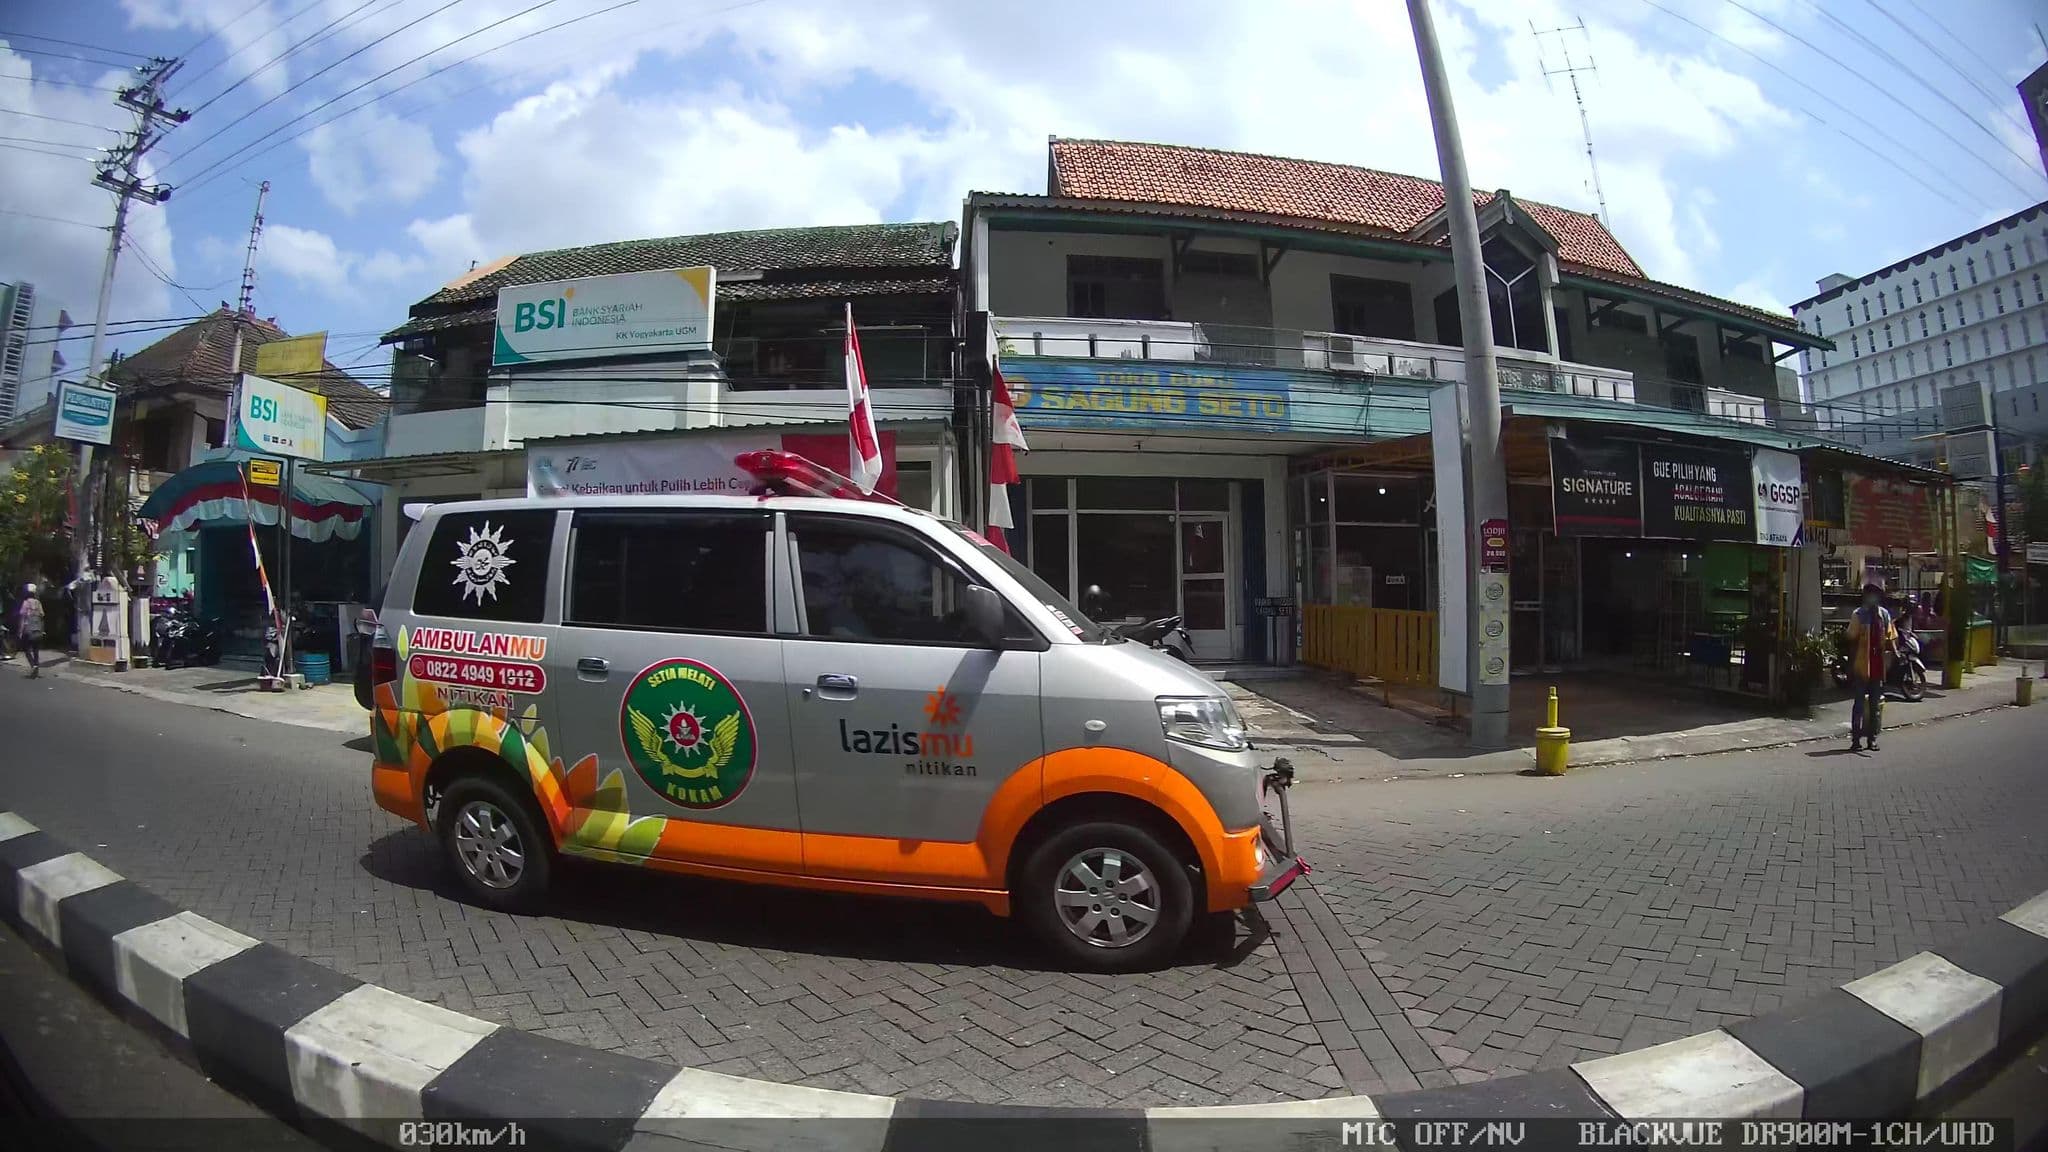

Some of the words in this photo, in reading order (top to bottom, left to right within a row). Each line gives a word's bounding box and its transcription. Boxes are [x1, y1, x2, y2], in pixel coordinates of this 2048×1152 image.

[514, 298, 566, 333] BSI
[571, 314, 627, 326] INDONESIA
[572, 306, 600, 316] BANK
[600, 303, 643, 314] SYARIAH
[629, 328, 674, 340] Yogyakarta
[675, 326, 697, 336] UGM
[250, 395, 277, 423] BSI
[1041, 387, 1186, 414] SAGUNG
[1198, 393, 1286, 417] SETO
[1653, 461, 1671, 478] GUE
[1672, 463, 1694, 480] PILIH
[1694, 465, 1717, 482] YANG
[572, 478, 622, 495] Kebaikan
[625, 479, 658, 493] untuk
[661, 478, 690, 492] Pulih
[693, 477, 725, 491] Lebih
[1563, 477, 1632, 496] SIGNATURE
[1674, 505, 1726, 523] KUALITASNYA
[1726, 509, 1746, 525] PASTI
[410, 627, 547, 661] AMBULANMU
[426, 661, 458, 680] 0822
[461, 664, 494, 684] 4949
[647, 667, 677, 688] SETIA
[677, 667, 717, 690] MELATI
[437, 687, 515, 710] NITIKAN
[840, 718, 975, 758] lazismu
[905, 760, 977, 777] nitikan
[666, 782, 723, 803] KOKAM
